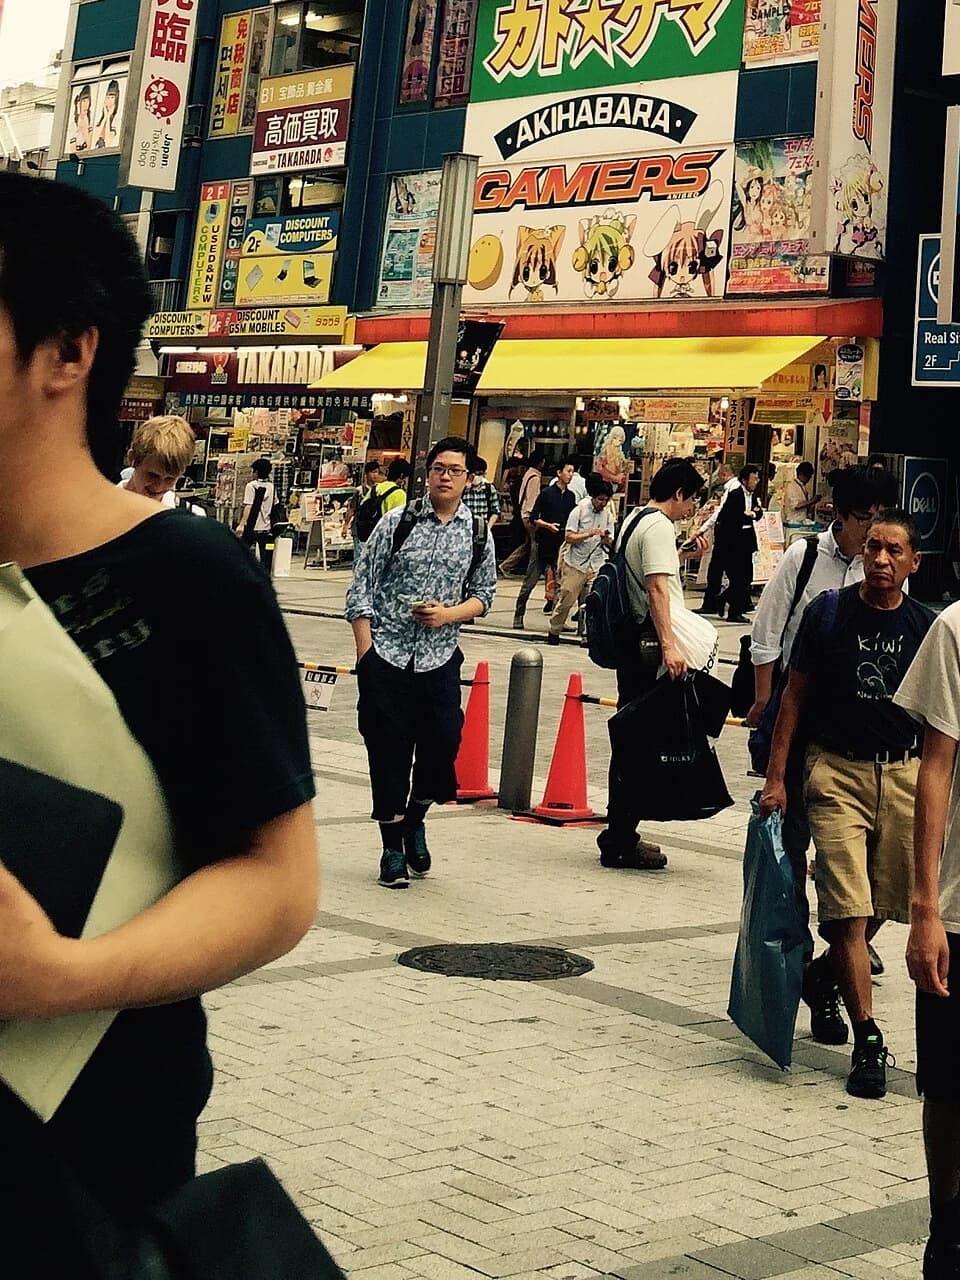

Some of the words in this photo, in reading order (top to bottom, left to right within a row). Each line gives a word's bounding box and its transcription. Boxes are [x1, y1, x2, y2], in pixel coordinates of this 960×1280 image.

[750, 5, 790, 21] SAMPLE
[227, 18, 248, 116] 免税商店
[261, 86, 274, 104] B1
[264, 107, 339, 147] 高価買取
[515, 95, 671, 150] AKIHABARA
[276, 148, 322, 169] TAKARADA
[474, 149, 727, 213] GAMERS
[206, 187, 225, 201] 2F
[285, 216, 330, 231] DISCOUNT
[279, 229, 333, 244] COMPUTERS
[246, 237, 262, 253] 2F
[192, 225, 209, 304] COMPUTERS
[793, 266, 826, 276] SAMPLE
[154, 313, 193, 325] DISCOUNT
[237, 309, 280, 322] DISCOUNT
[149, 324, 195, 336] COMPUTERS
[229, 323, 247, 335] GSM
[249, 321, 287, 334] MOBILES
[924, 331, 948, 345] Real
[237, 350, 335, 385] TAKARADA
[924, 354, 937, 368] 2F
[912, 498, 935, 514] DELL
